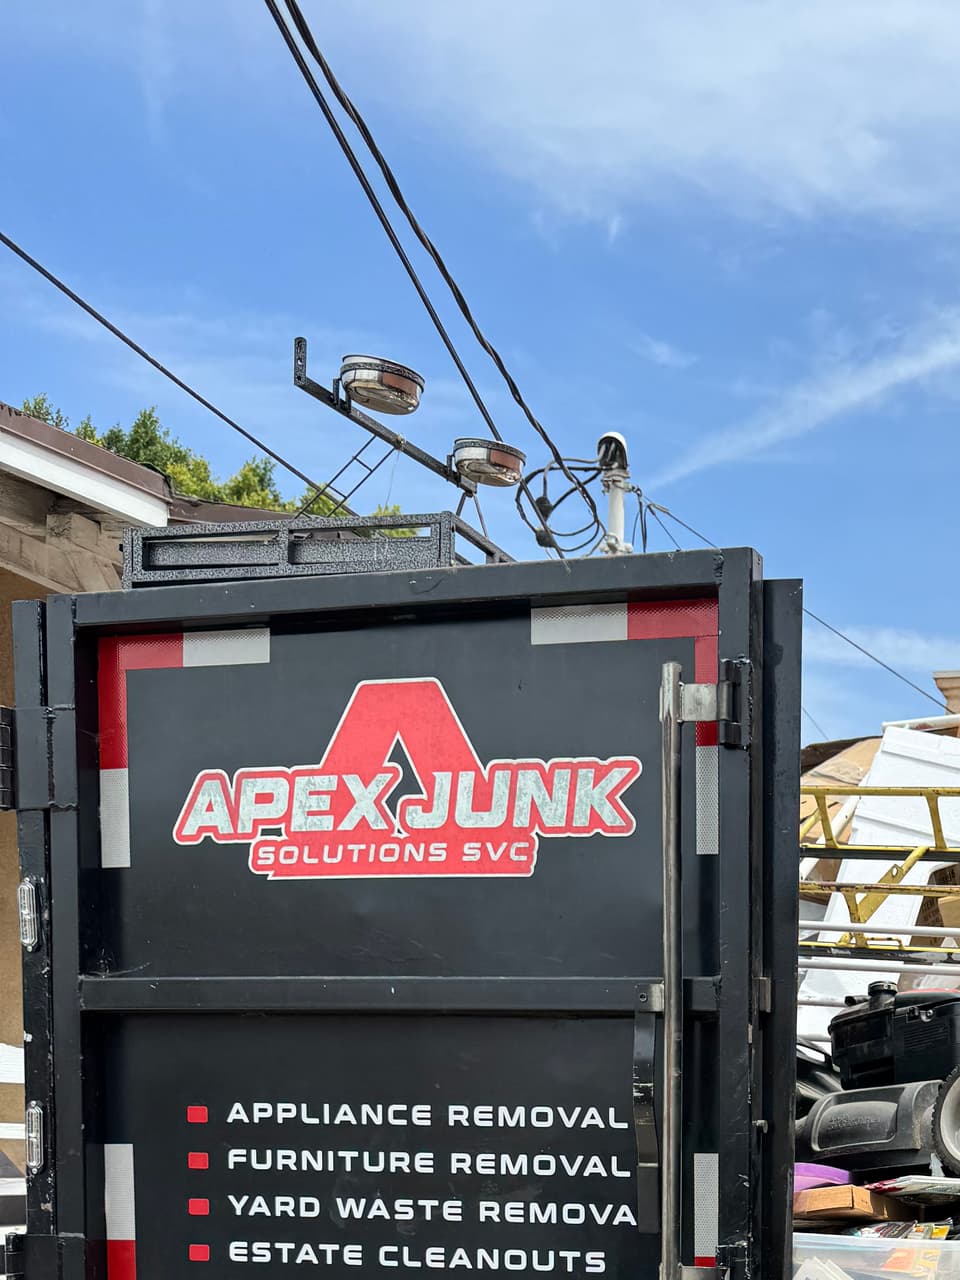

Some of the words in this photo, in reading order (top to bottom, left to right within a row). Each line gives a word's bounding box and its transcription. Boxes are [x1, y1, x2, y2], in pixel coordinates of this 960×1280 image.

[181, 772, 394, 836] APEX
[405, 767, 633, 829] JUNK
[257, 842, 447, 865] SOLUTIONS
[462, 842, 529, 862] SVC
[226, 1102, 432, 1125] APPLIANCE
[447, 1104, 629, 1129] REMOVAL
[227, 1149, 435, 1174] FURNITURE
[450, 1151, 631, 1177] REMOVAL
[227, 1194, 321, 1218] YARD
[336, 1197, 463, 1221] WASTE
[479, 1201, 637, 1226] REMOVA
[228, 1240, 363, 1266] ESTATE
[378, 1244, 606, 1273] CLEANOUTS
